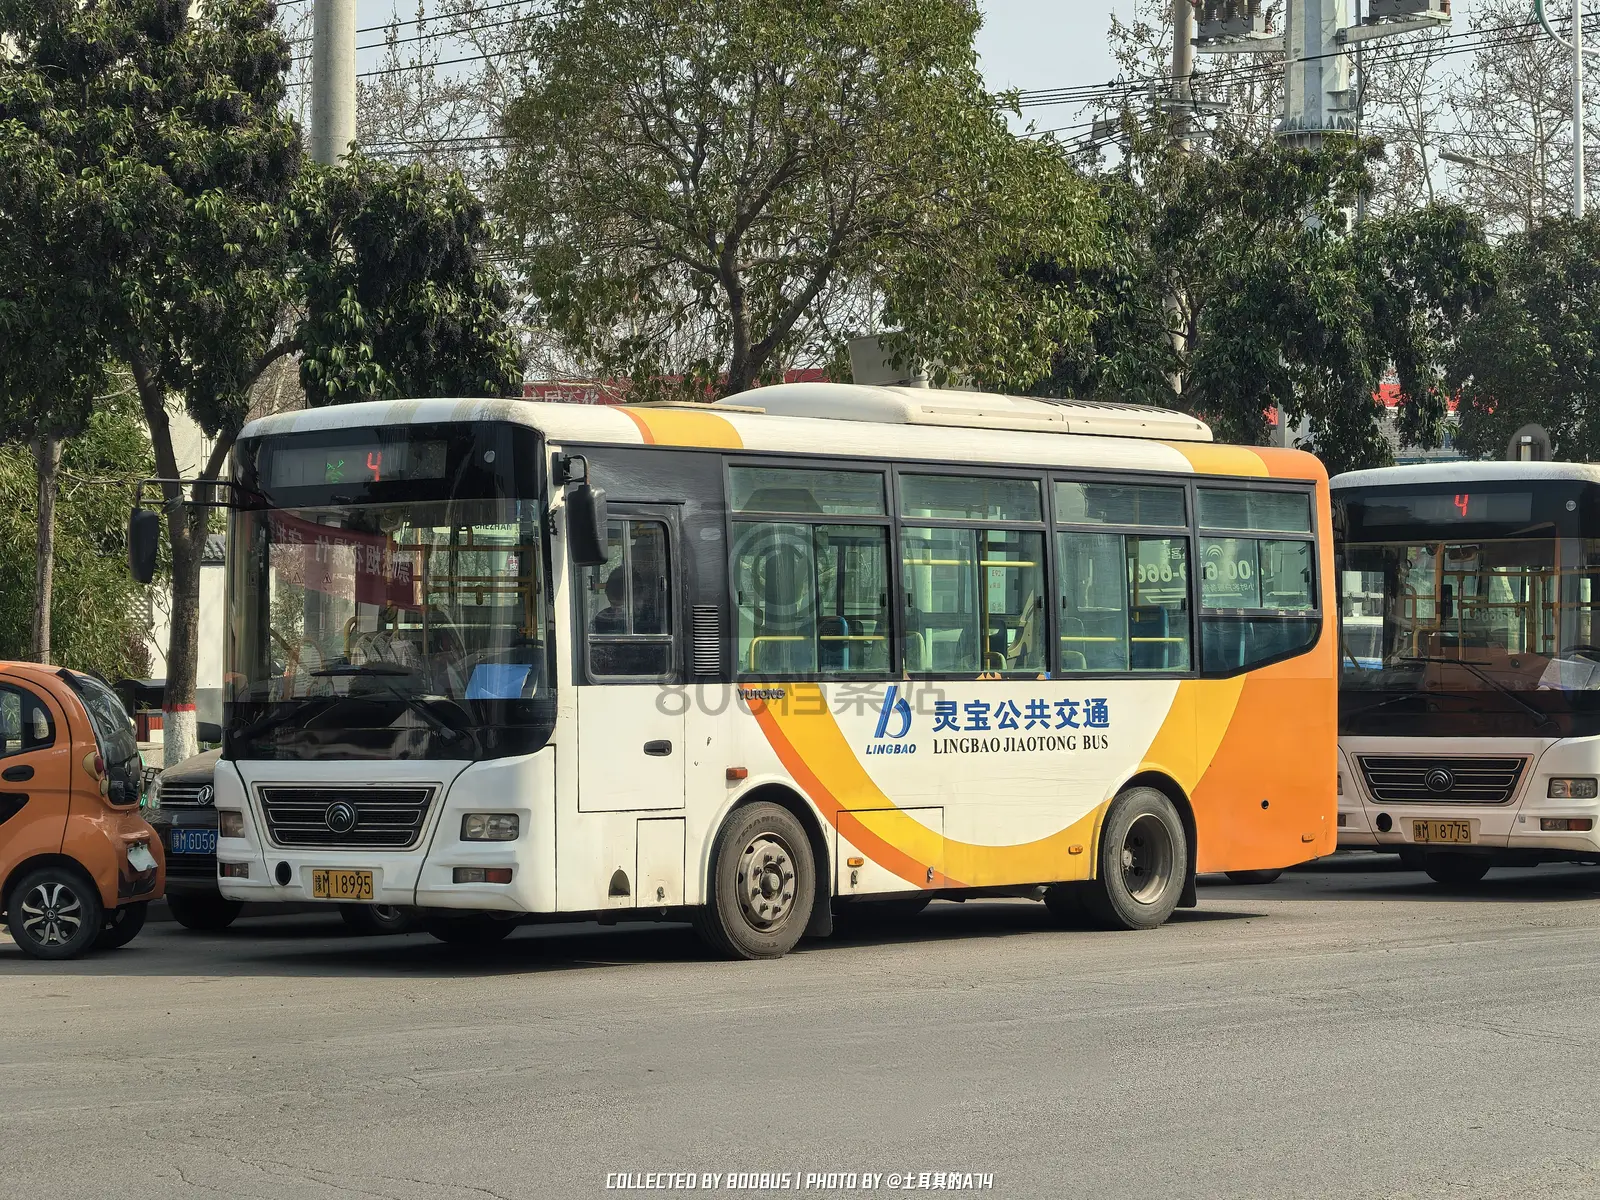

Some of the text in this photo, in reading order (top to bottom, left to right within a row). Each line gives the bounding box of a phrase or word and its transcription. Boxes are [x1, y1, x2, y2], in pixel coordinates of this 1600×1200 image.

[366, 450, 383, 482] 4
[1454, 493, 1469, 517] 4
[737, 688, 786, 700] YUTONG
[932, 698, 1110, 733] 灵宝公共交通
[865, 744, 917, 755] LINGBAO
[932, 734, 1109, 755] LINGBAO JIAOTONG BUS
[172, 833, 216, 850] 豫M·GD58
